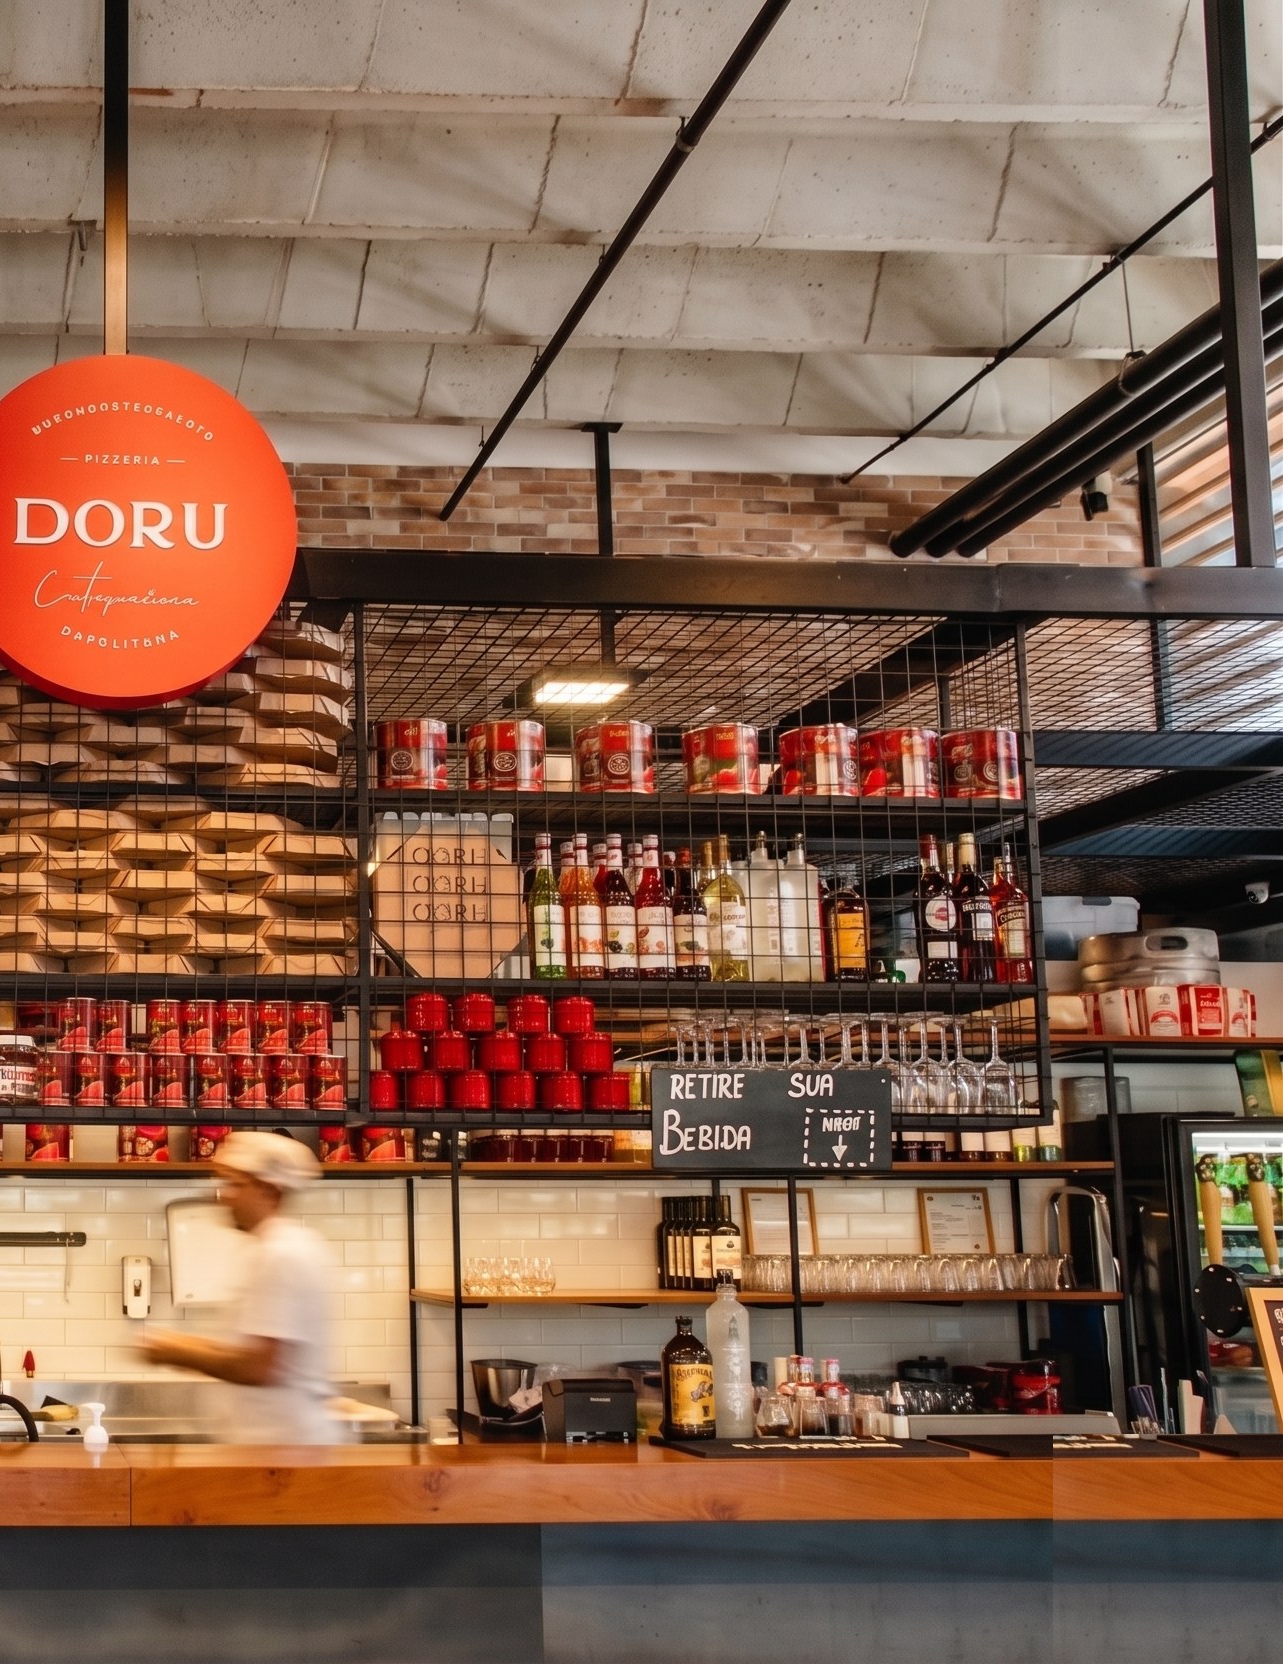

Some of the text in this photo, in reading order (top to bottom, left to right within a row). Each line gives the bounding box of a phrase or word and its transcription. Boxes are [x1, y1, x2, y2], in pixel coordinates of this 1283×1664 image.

[84, 454, 160, 466] PIZZERIA
[13, 497, 229, 550] DORU
[670, 1072, 834, 1100] RETIRE SUA
[659, 1108, 751, 1156] BEBIDA
